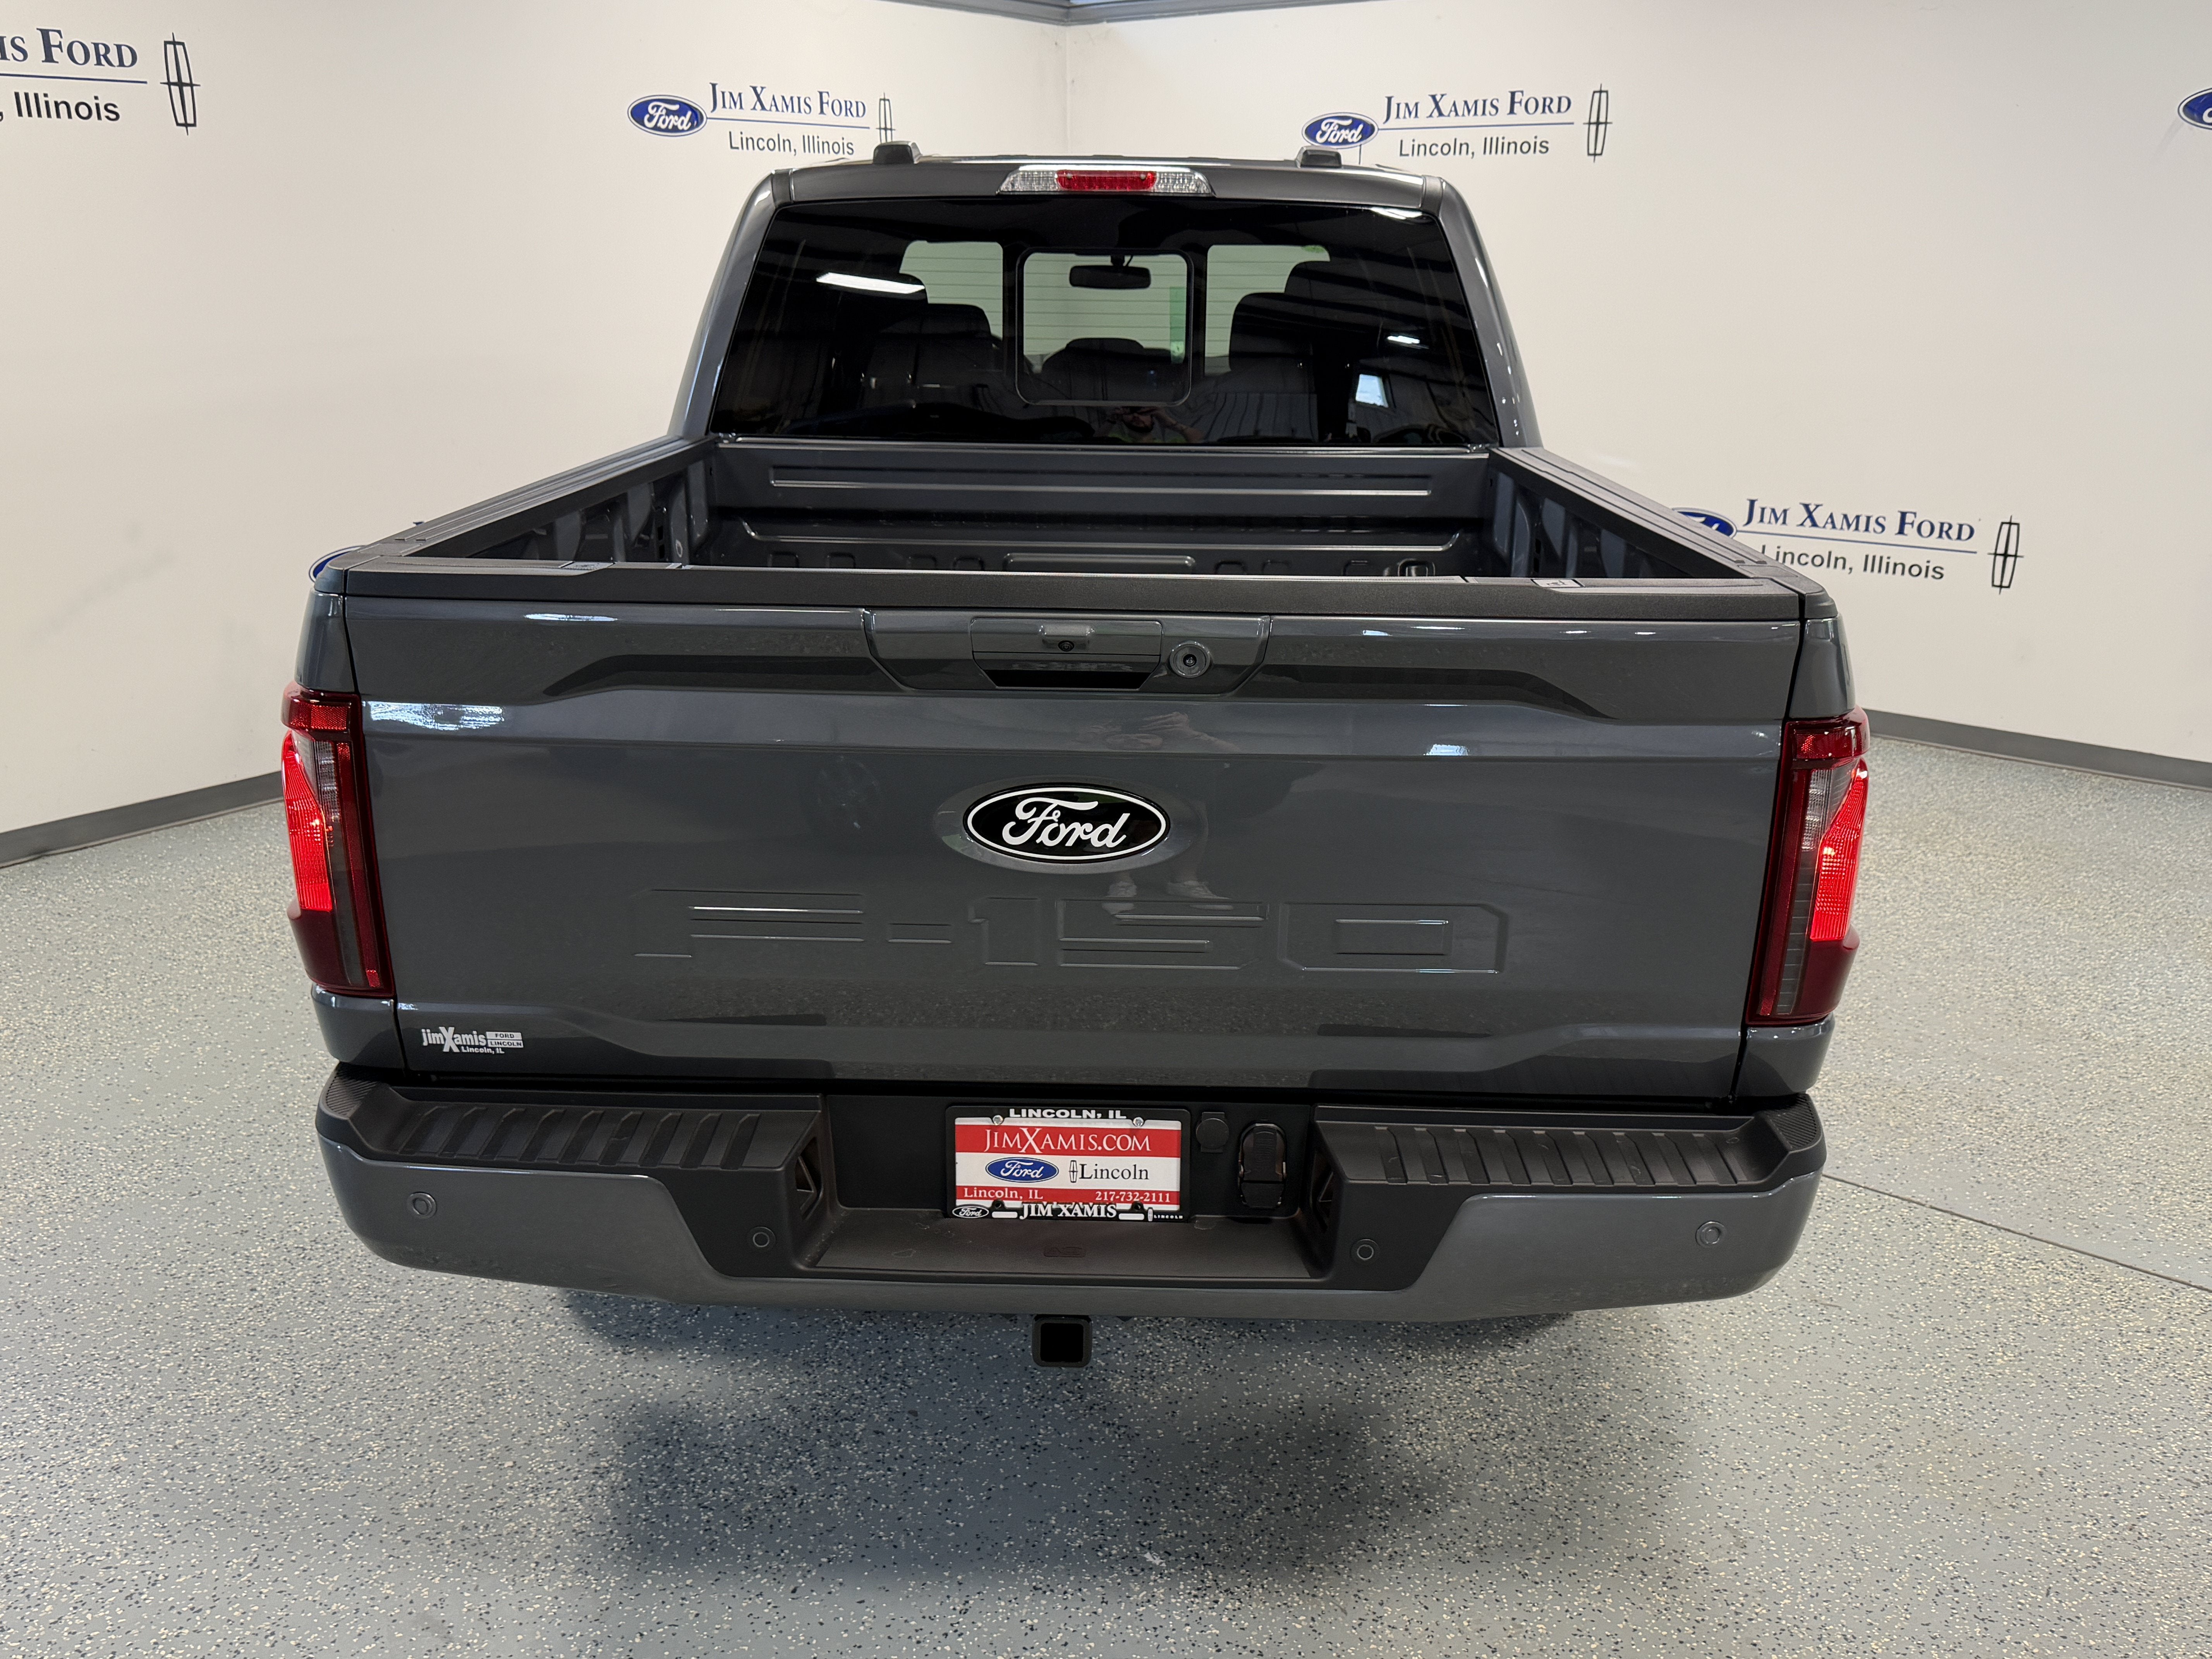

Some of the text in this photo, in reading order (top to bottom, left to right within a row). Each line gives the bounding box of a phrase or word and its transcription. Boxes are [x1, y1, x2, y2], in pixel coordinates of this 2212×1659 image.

[36, 28, 137, 67] FORD
[14, 92, 120, 121] Illinois
[710, 82, 866, 117] JIM XAMIS FORD
[1383, 91, 1571, 124] JIM XAMIS FORD
[644, 101, 692, 131] Ford
[1316, 118, 1364, 143] Ford
[729, 131, 854, 156] Lincoln, Illinois
[1400, 136, 1549, 158] Lincoln, Illinois
[1743, 499, 1790, 526] JIM
[1797, 503, 1886, 534] XAMIS
[1895, 511, 1974, 541] FORD
[1863, 555, 1944, 579] Illinois
[1002, 797, 1130, 848] Ford
[461, 1046, 495, 1054] Lincoln,
[1010, 1109, 1127, 1119] LINCOLN, IL
[984, 1128, 1151, 1154] JIMXAMIS.COM
[1000, 1161, 1043, 1178] Ford
[1079, 1164, 1149, 1180] Lincoln
[964, 1188, 1170, 1202] Lincoln, IL 217-732-2111
[959, 1207, 982, 1216] Ford
[1020, 1203, 1116, 1219] JIM XAMIS
